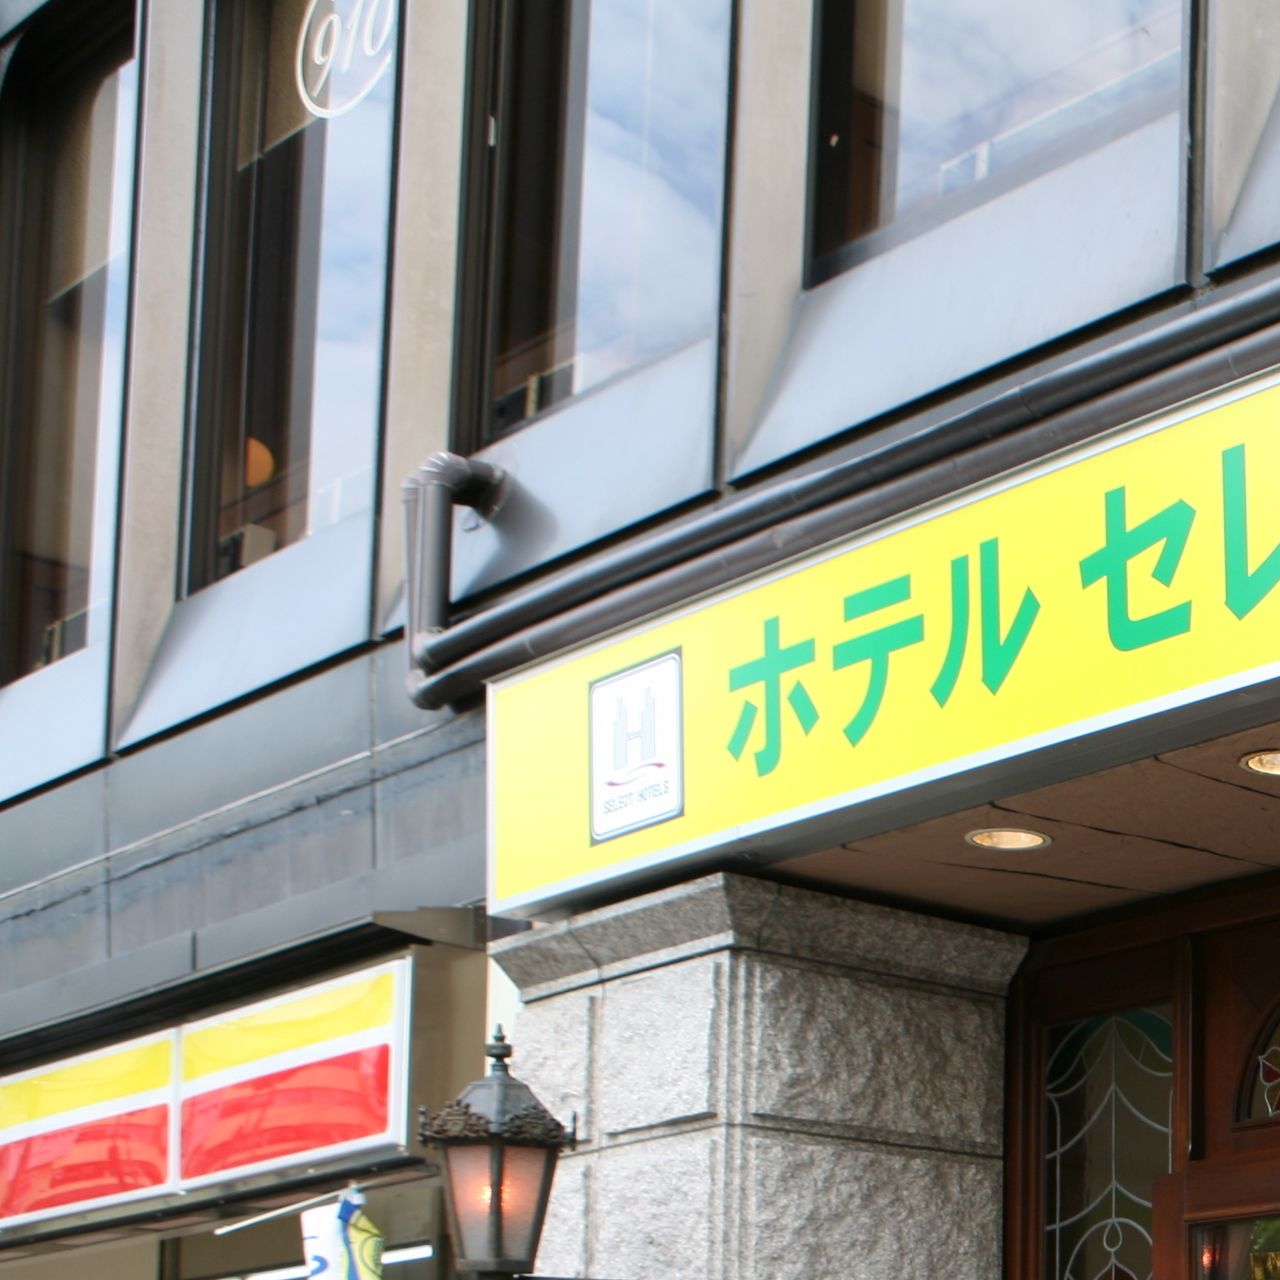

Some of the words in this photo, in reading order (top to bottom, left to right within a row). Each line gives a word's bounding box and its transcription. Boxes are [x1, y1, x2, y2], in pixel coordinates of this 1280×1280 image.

[313, 0, 395, 98] 910
[727, 540, 1040, 776] ホテル
